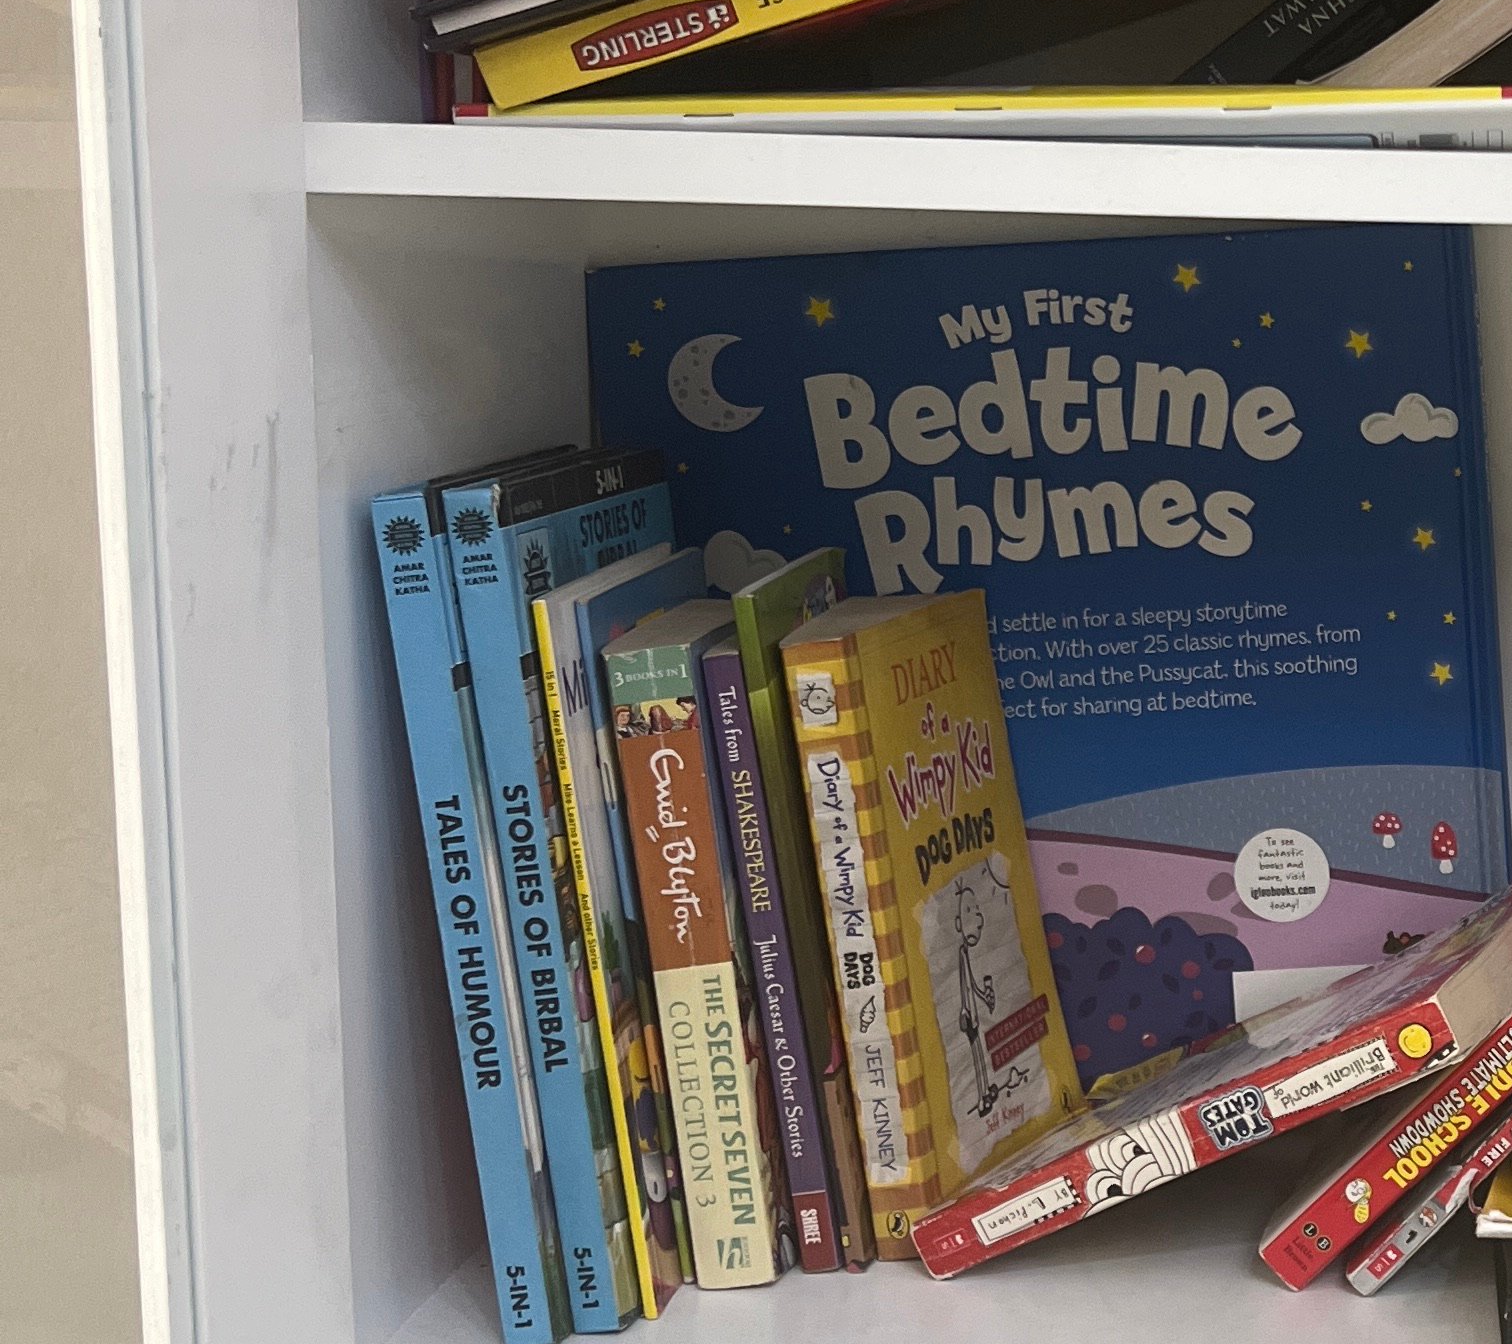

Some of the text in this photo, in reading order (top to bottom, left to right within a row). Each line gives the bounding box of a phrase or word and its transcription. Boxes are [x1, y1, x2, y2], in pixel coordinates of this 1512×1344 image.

[579, 11, 706, 67] STERLING
[937, 289, 1134, 349] My First
[803, 346, 1303, 489] Bedtime
[393, 562, 425, 573] AMAR
[854, 475, 1256, 596] Rhymes
[393, 574, 429, 584] CHITRA
[395, 585, 430, 596] KATHA
[1003, 611, 1056, 632] settle
[1062, 615, 1079, 629] in
[1083, 608, 1110, 628] for
[1115, 613, 1127, 626] a
[1131, 605, 1190, 632] sleepy
[1196, 600, 1288, 626] storytime
[891, 641, 957, 705] DIARY
[1020, 654, 1358, 689] Owl and the this soothing
[716, 685, 771, 913] Tales from SHAKESPEARE
[888, 719, 995, 830] Wimpy Kid
[649, 747, 703, 944] Enid Blyton
[816, 756, 866, 939] Diary of a Wimpy Kid
[915, 807, 995, 886] DOG DAYS
[433, 793, 502, 1090] TALES OF HUMOUR
[500, 782, 571, 1073] STORIES OF BIRBAL
[752, 934, 811, 1157] Julius Caesar Other Stories
[1321, 1045, 1388, 1090] Brilliant
[667, 999, 717, 1208] COLLECTION 3
[702, 974, 756, 1226] THE SECRET SEVEN
[864, 1043, 897, 1172] JEFF KINNEY
[1200, 1088, 1261, 1130] GATES
[1210, 1109, 1269, 1147] TOM
[1386, 1082, 1465, 1161] SHOWDOWN
[1381, 1106, 1475, 1193] SCHOOL
[1479, 1136, 1511, 1167] FIRE
[799, 1208, 822, 1245] SHREE
[501, 1262, 537, 1330] 5-IN-1
[571, 1244, 601, 1310] 5-IN-1
